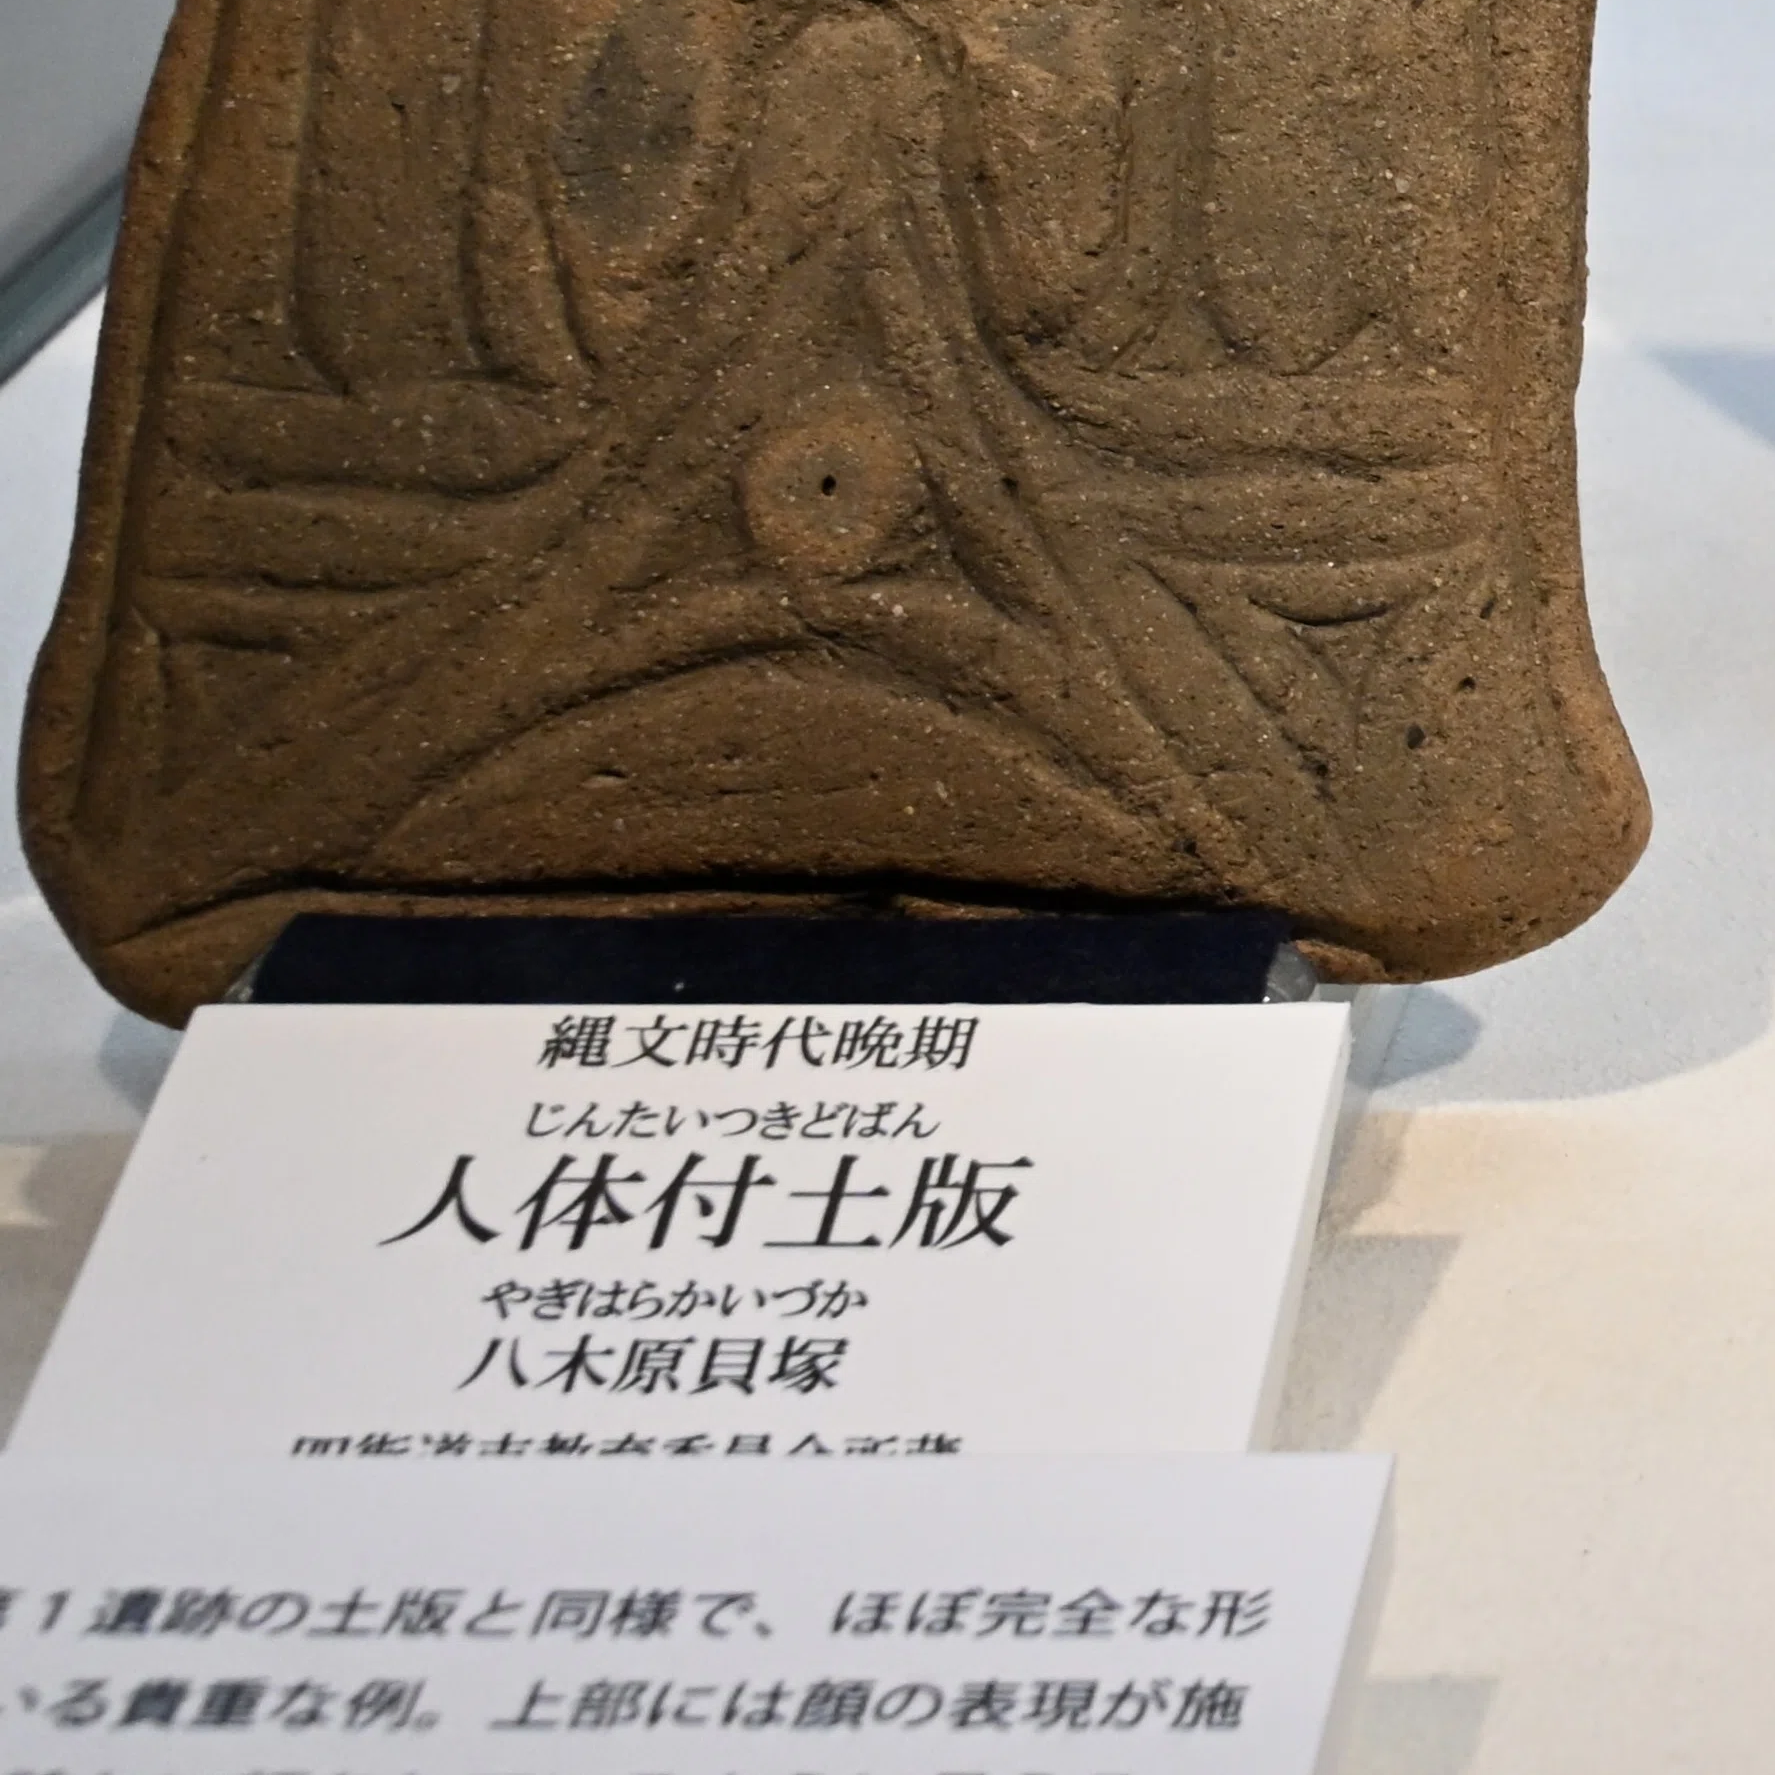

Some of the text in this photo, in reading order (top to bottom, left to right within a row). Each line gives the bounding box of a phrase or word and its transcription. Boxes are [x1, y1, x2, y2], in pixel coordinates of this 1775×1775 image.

[536, 1013, 981, 1071] 縄文時代晩期
[525, 1099, 941, 1142] じんたいつきどばん
[378, 1150, 1035, 1253] 人体付土版
[480, 1277, 870, 1322] やぎはらかいづか
[457, 1332, 851, 1397] 八木原貝塚
